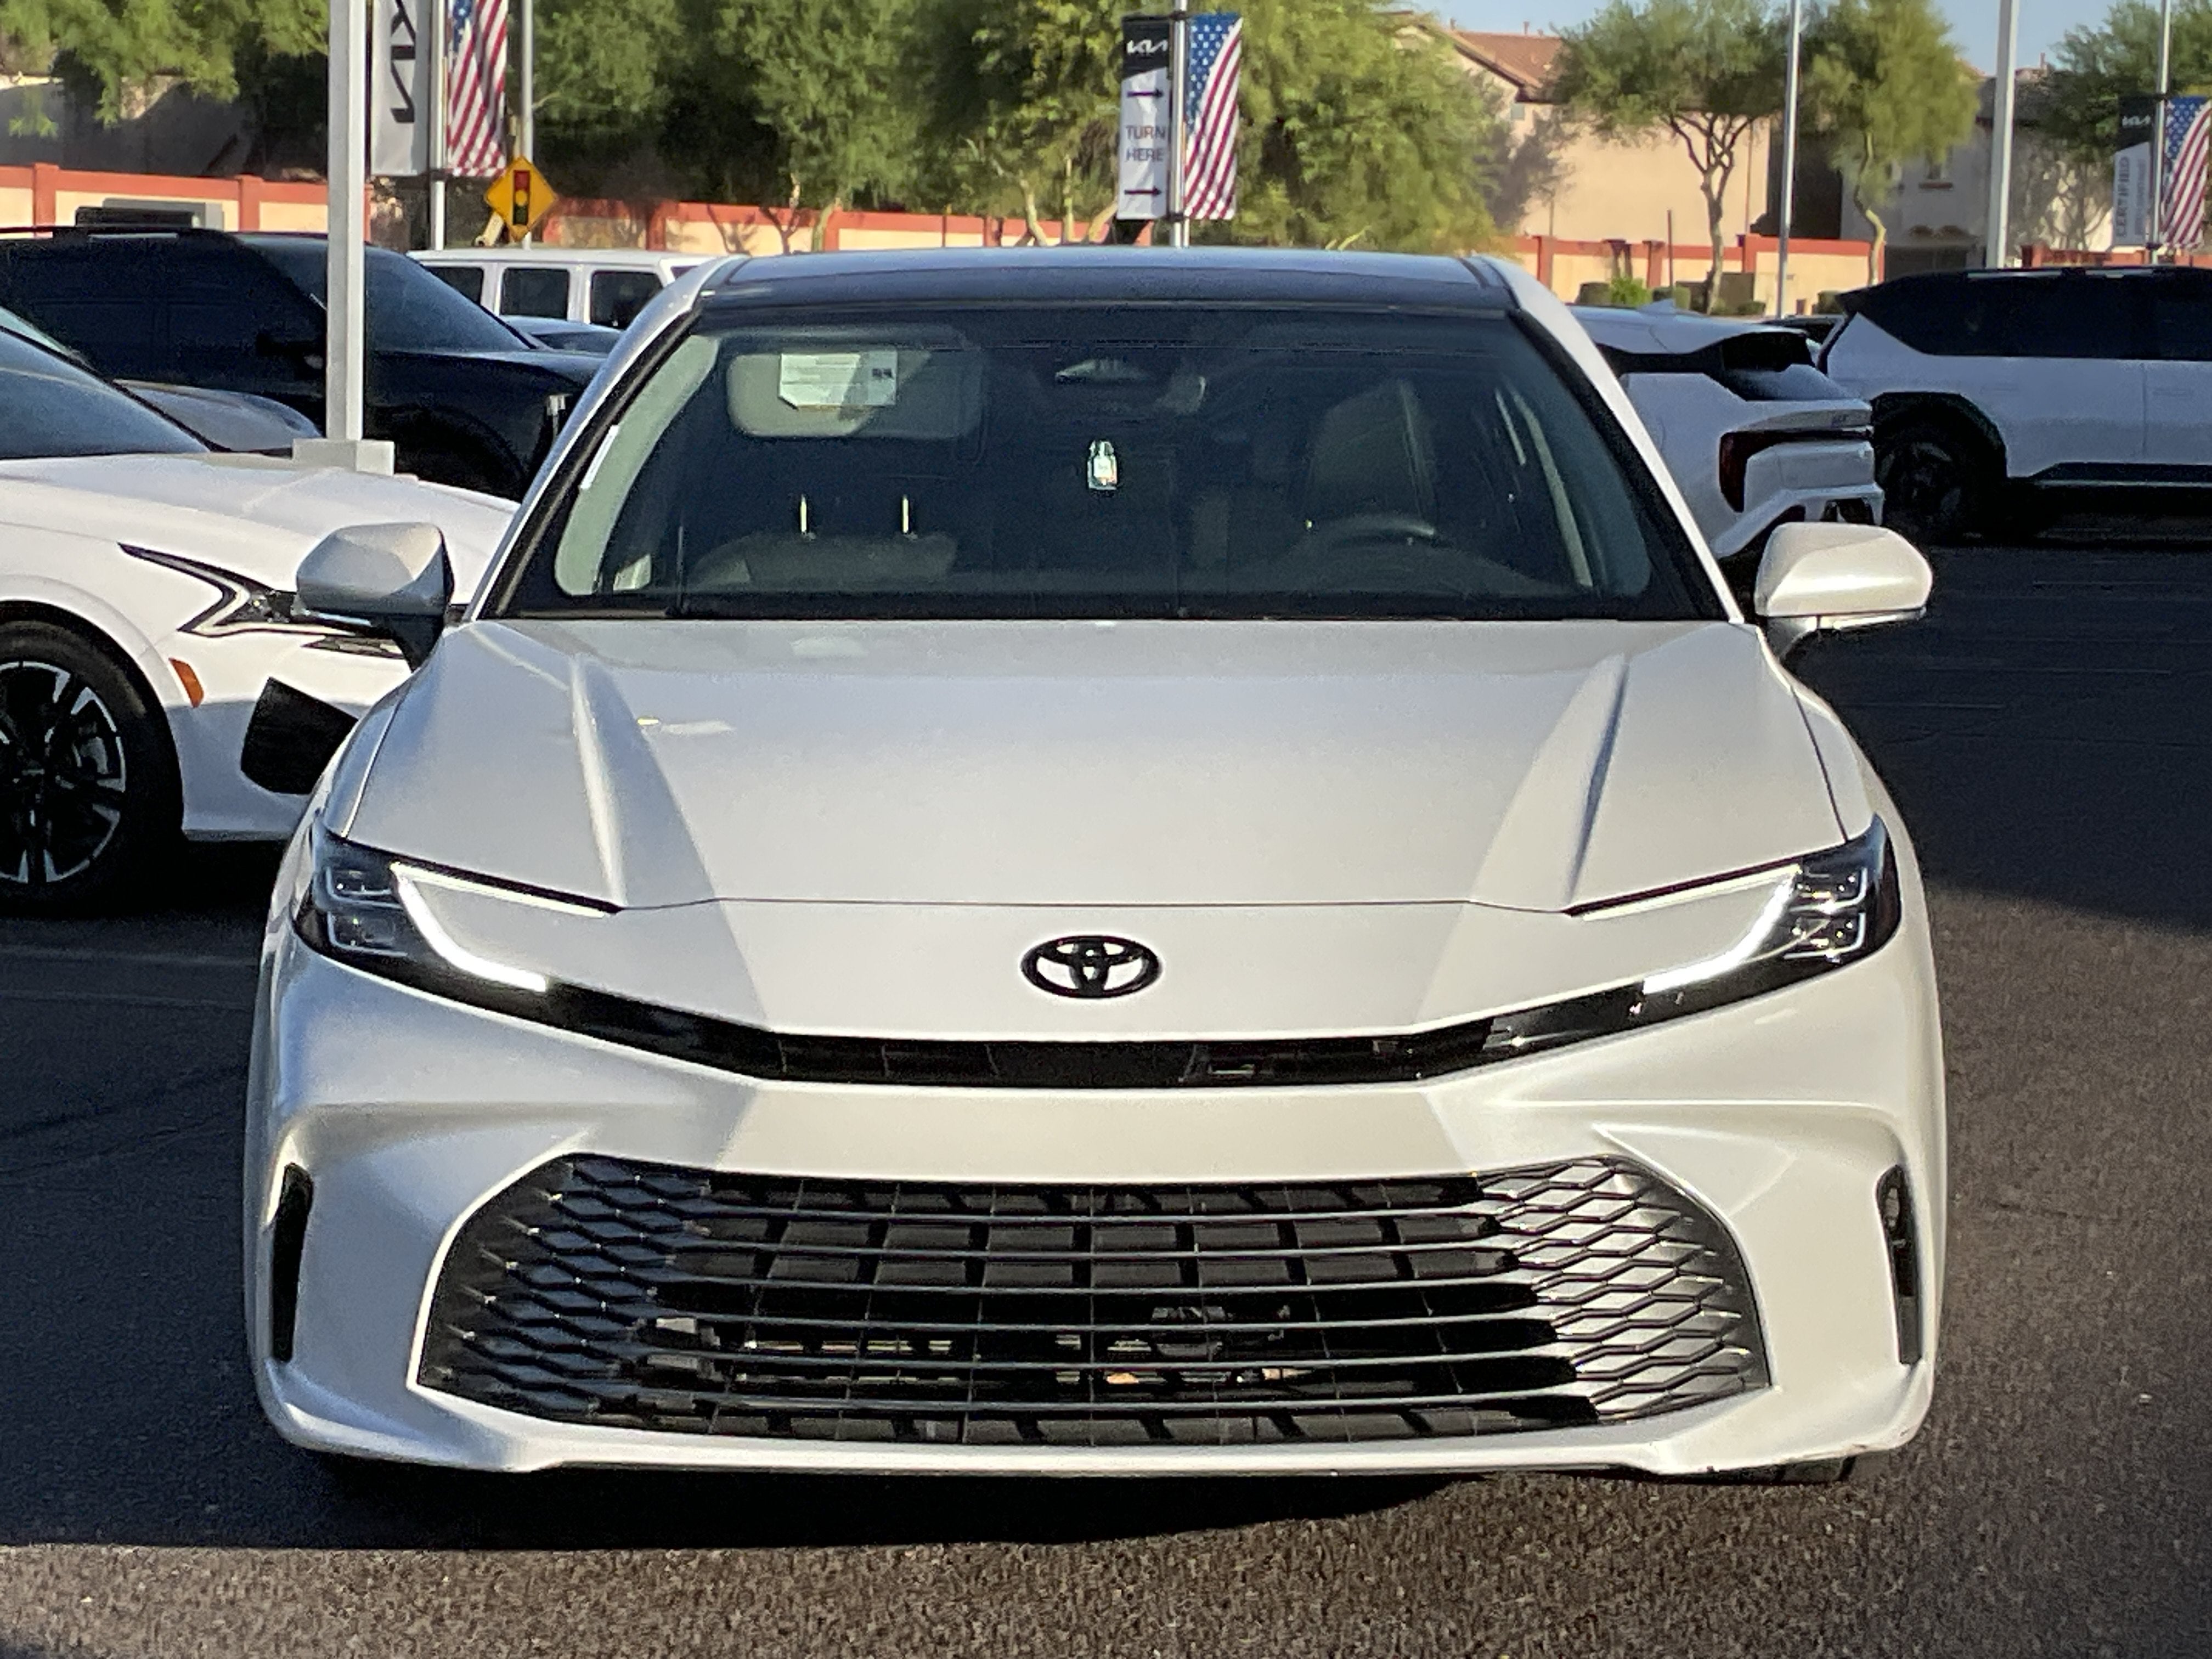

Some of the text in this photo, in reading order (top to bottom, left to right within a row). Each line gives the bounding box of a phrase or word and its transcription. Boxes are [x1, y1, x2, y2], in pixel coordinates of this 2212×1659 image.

[1125, 125, 1166, 141] TURN
[1125, 148, 1164, 161] HERE
[2115, 156, 2130, 238] CERTIFIED
